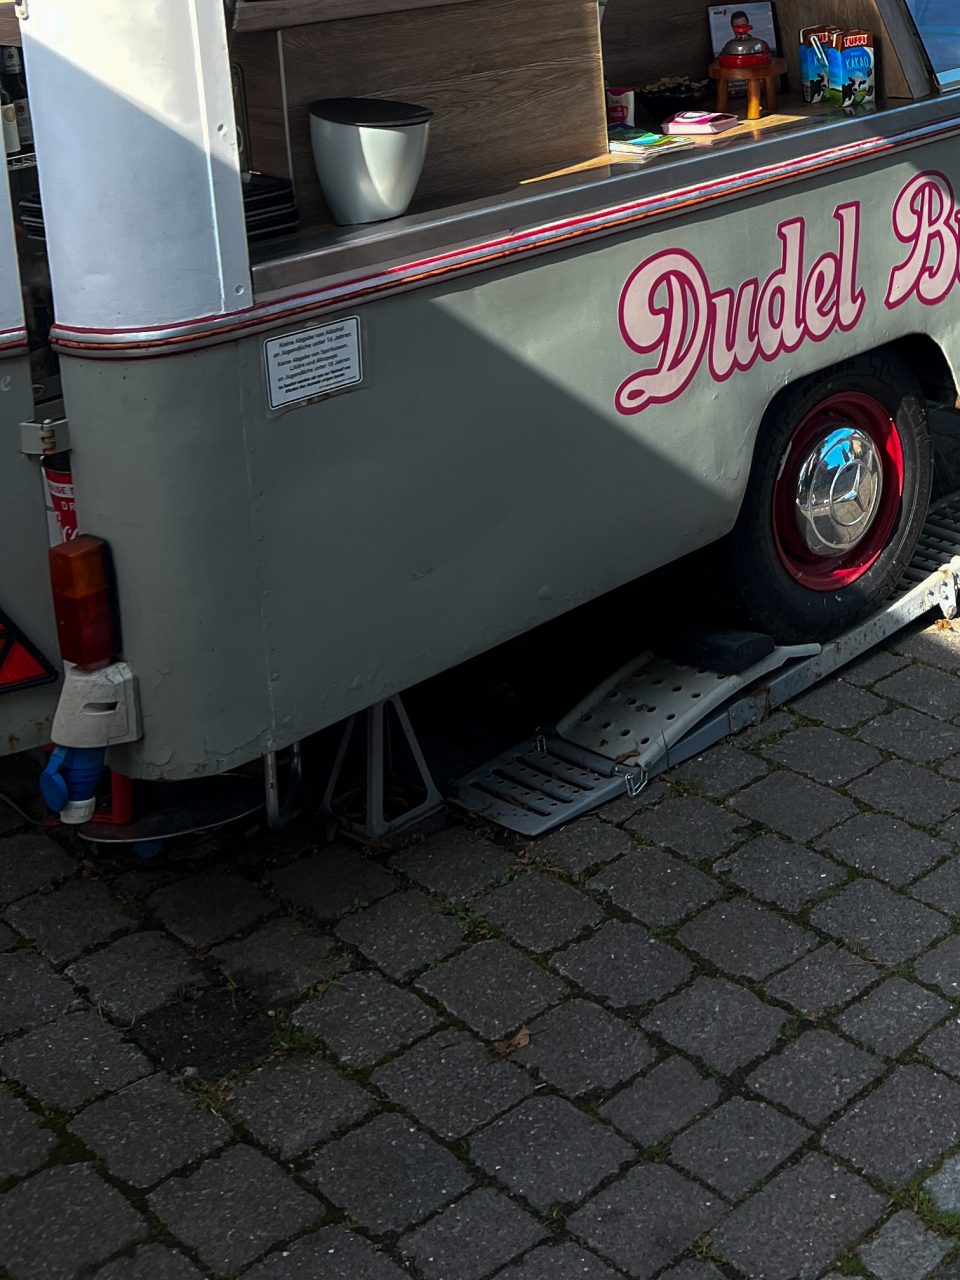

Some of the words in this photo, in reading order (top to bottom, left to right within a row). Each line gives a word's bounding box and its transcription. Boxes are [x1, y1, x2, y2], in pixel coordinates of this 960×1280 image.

[844, 34, 868, 47] TUFFI
[845, 56, 869, 70] KAKAO
[613, 200, 867, 416] Dudel
